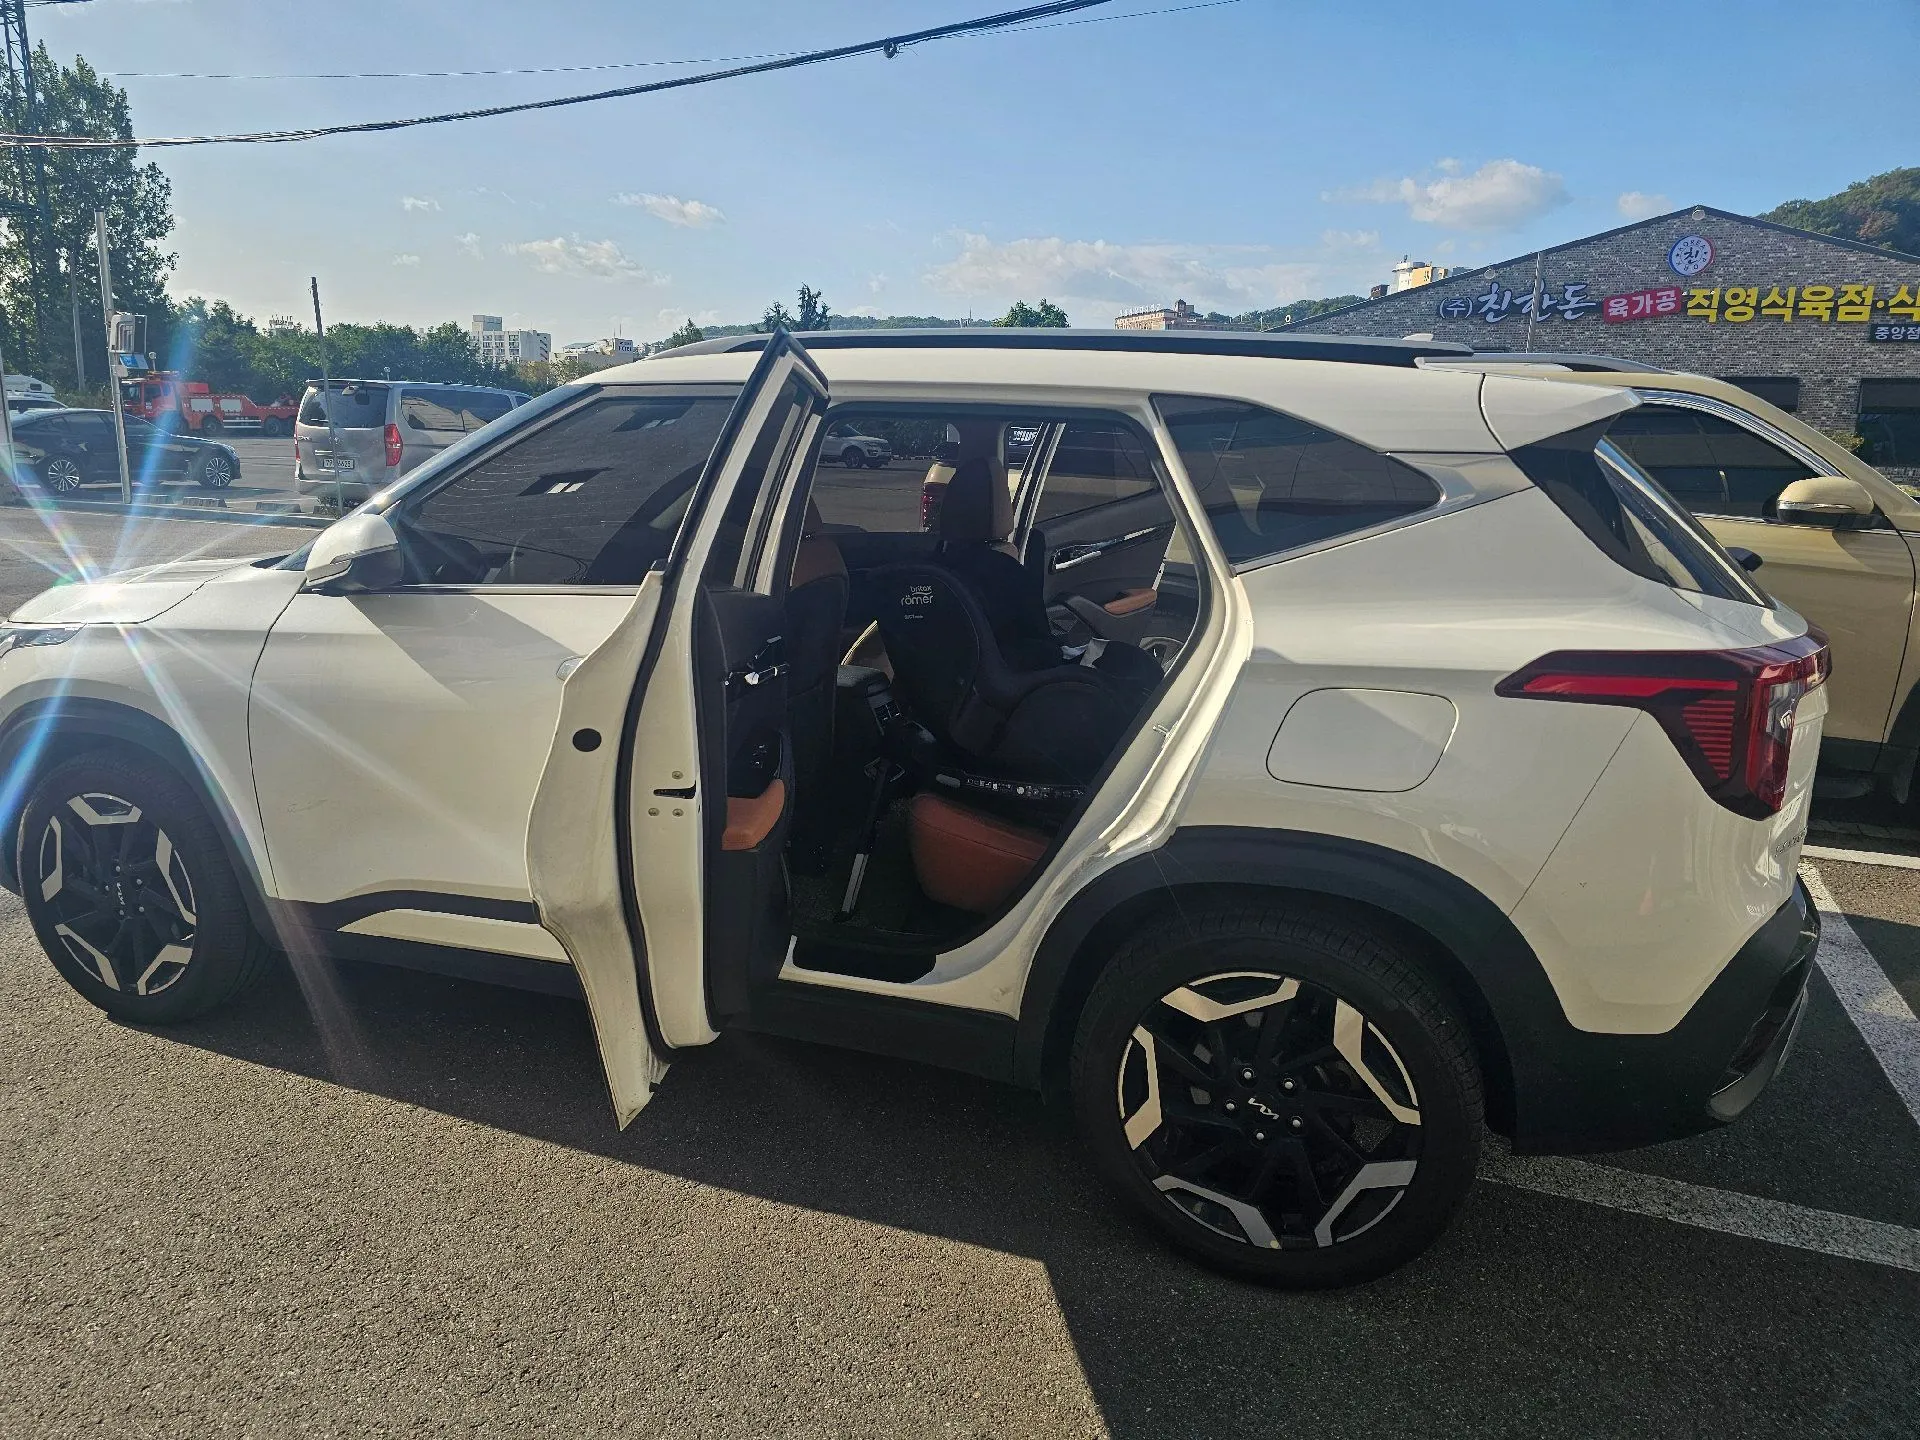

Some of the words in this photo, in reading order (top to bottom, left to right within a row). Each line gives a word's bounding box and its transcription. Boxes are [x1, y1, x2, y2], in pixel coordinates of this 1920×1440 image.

[1683, 247, 1700, 264] 친
[1608, 290, 1677, 317] 육가공
[1875, 326, 1920, 340] 중앙점
[910, 585, 932, 594] britax
[901, 595, 933, 606] römer
